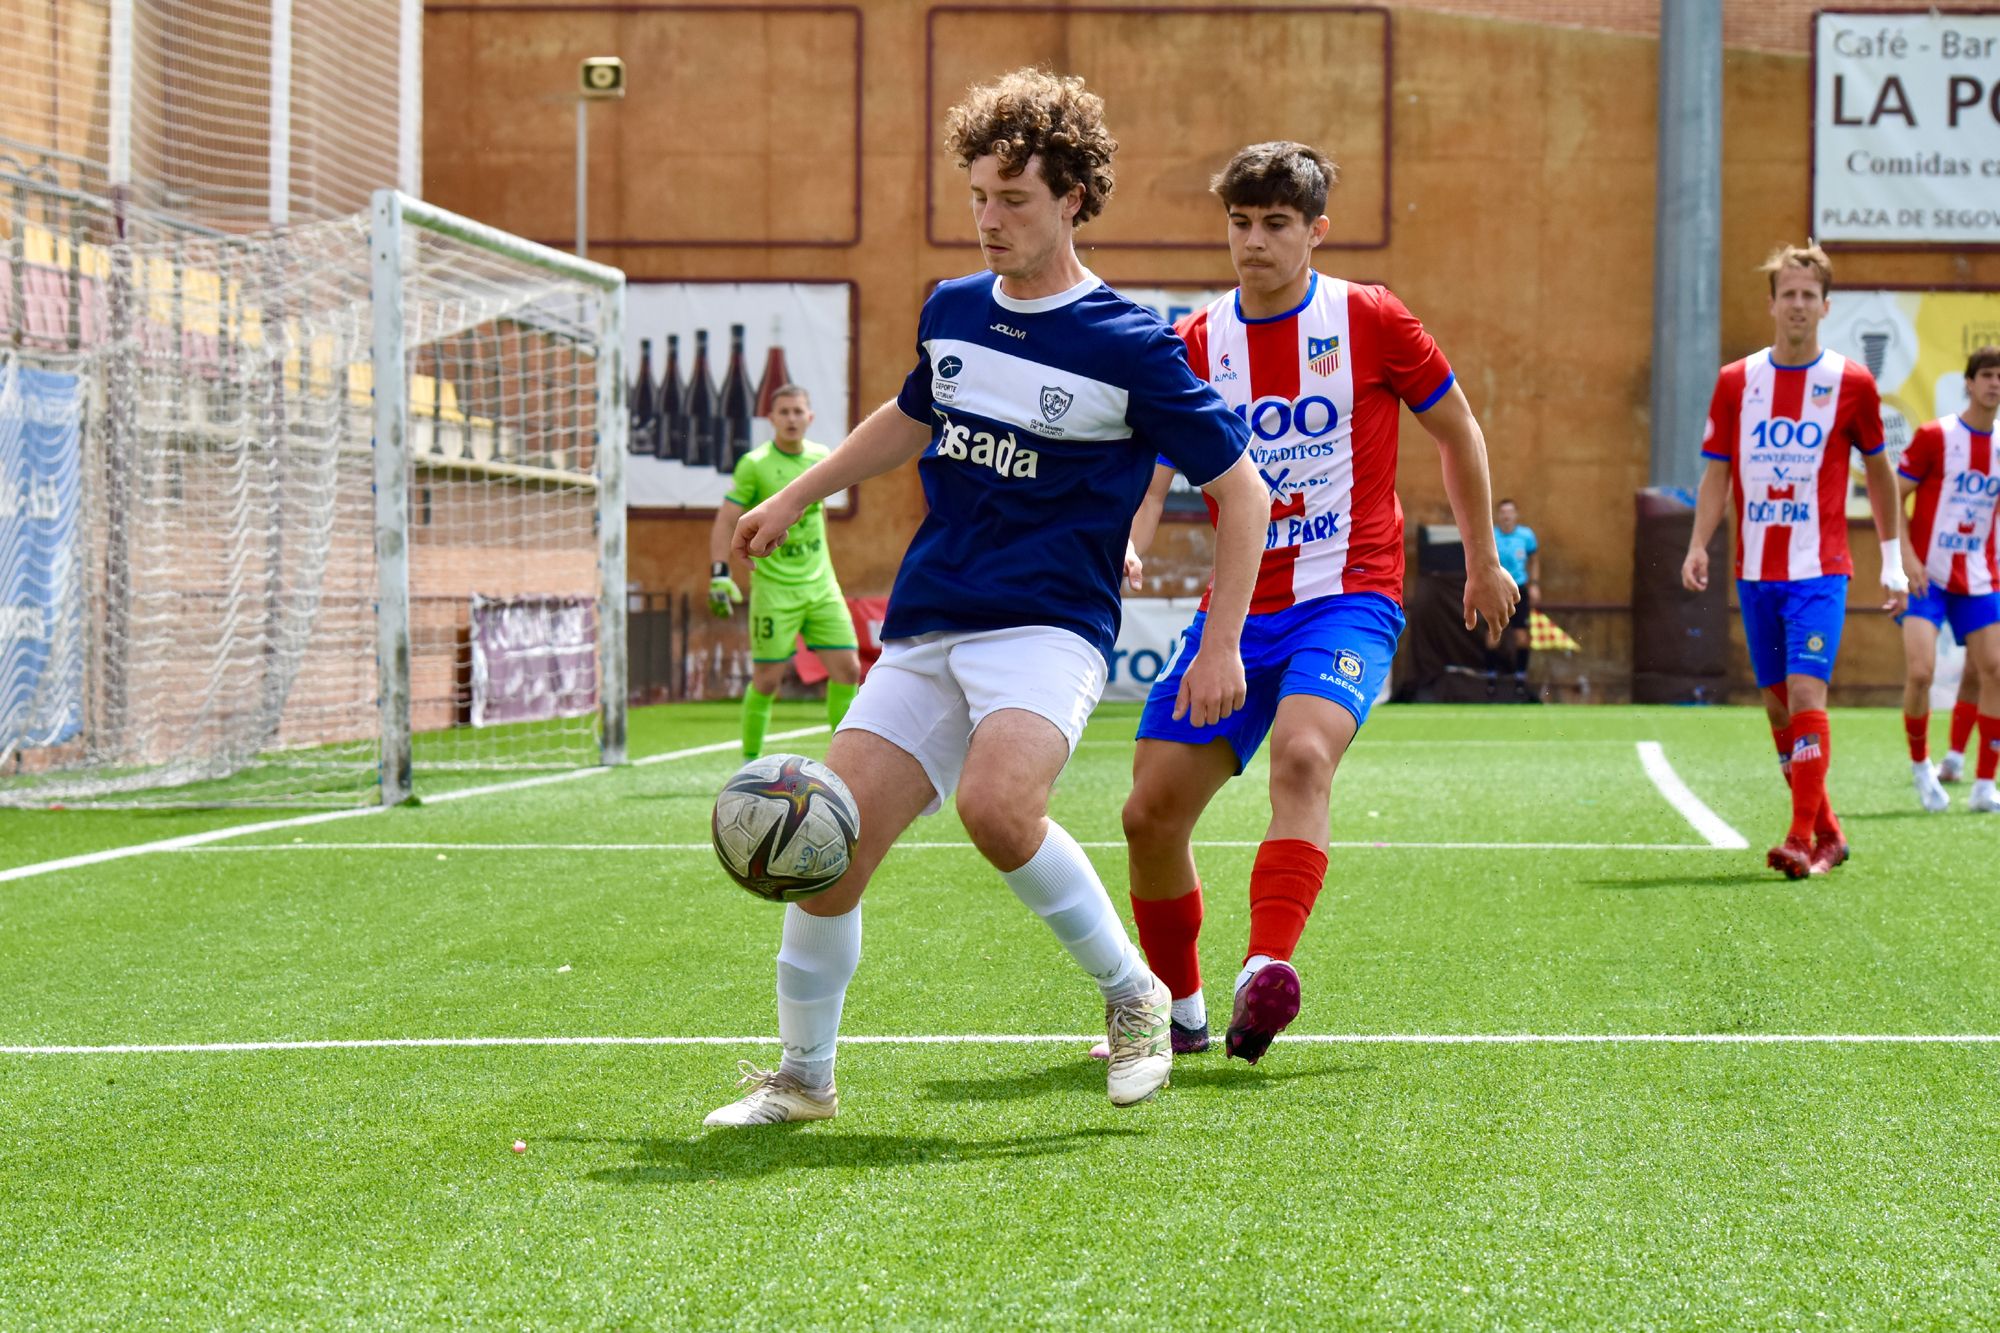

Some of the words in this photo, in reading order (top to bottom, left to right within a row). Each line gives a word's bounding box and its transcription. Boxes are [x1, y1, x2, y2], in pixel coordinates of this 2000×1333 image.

[1834, 28, 1908, 58] Café
[1941, 30, 1997, 59] Bar
[1833, 75, 1918, 127] LA
[1948, 76, 2000, 128] P
[1847, 150, 1971, 176] Comidas
[1823, 209, 1890, 227] PLAZA
[1899, 209, 1926, 228] DE
[1751, 420, 1822, 448] 100
[1954, 472, 2000, 497] 100
[1288, 511, 1340, 547] PARK
[1320, 673, 1365, 703] SASEGUR
